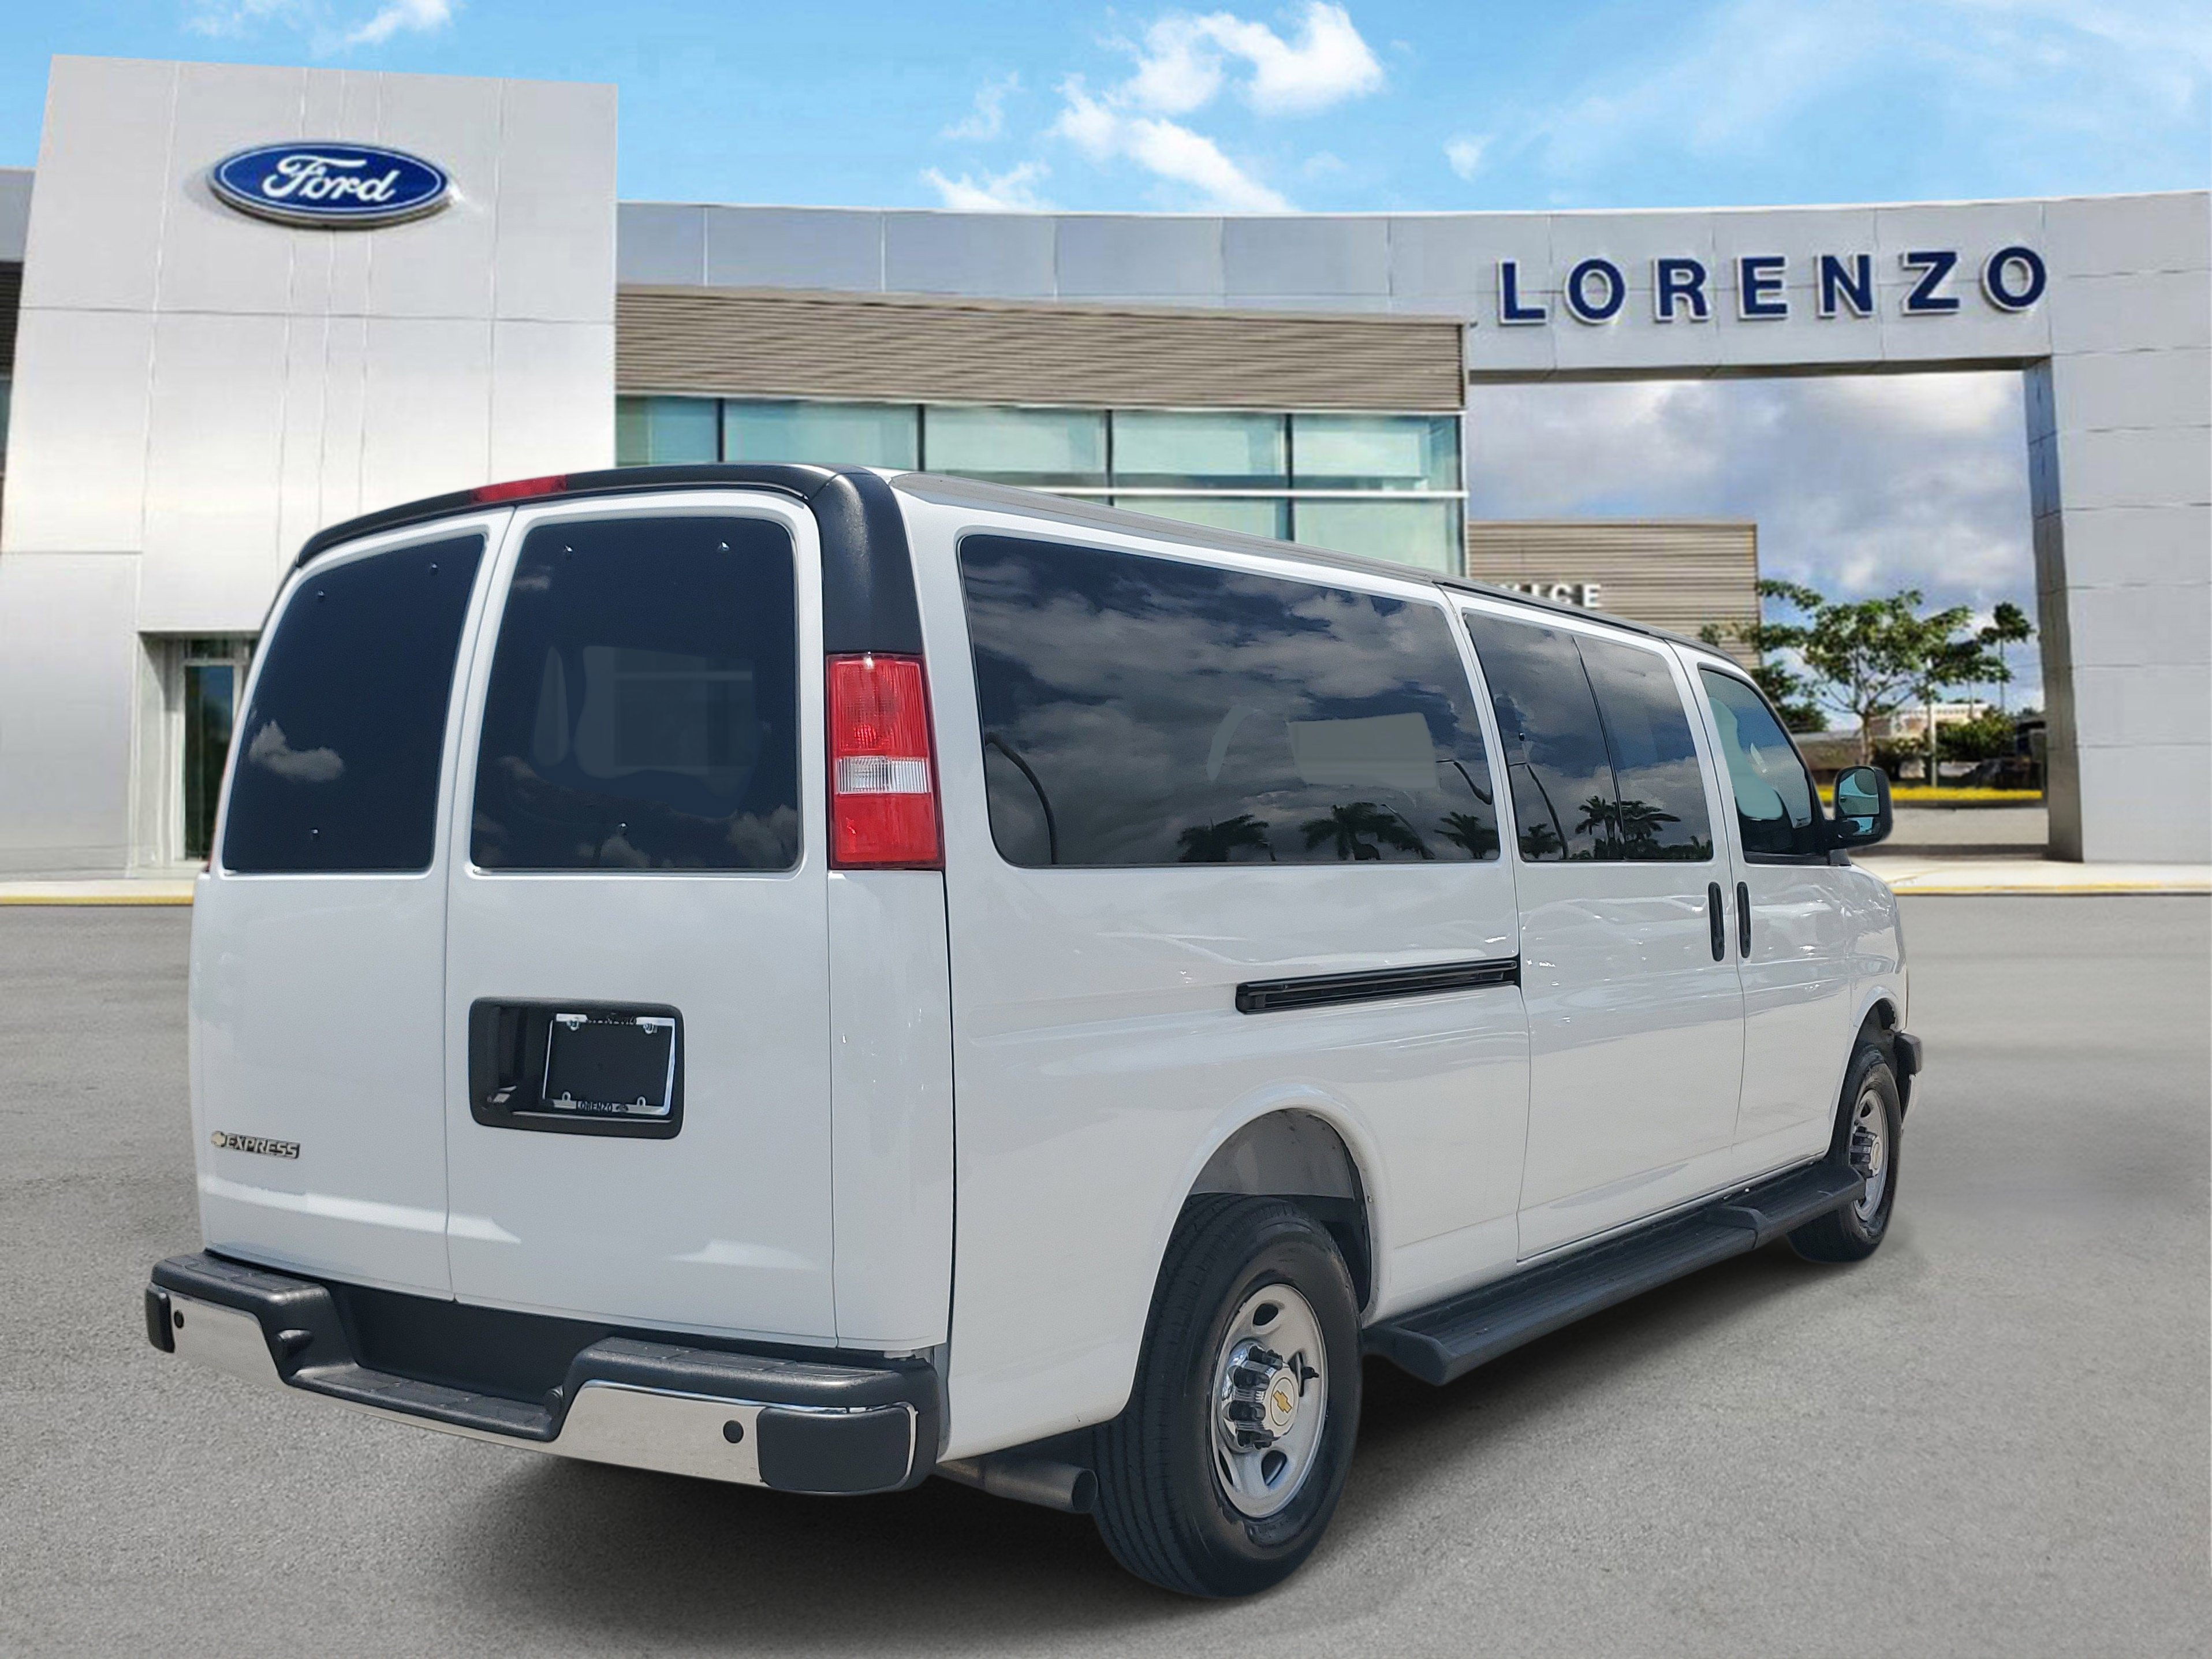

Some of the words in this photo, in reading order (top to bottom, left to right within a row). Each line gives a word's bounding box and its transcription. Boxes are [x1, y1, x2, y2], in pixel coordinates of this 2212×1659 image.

[262, 154, 401, 202] Ford
[1500, 246, 2047, 325] LORENZO
[226, 1133, 300, 1158] EXPRESS
